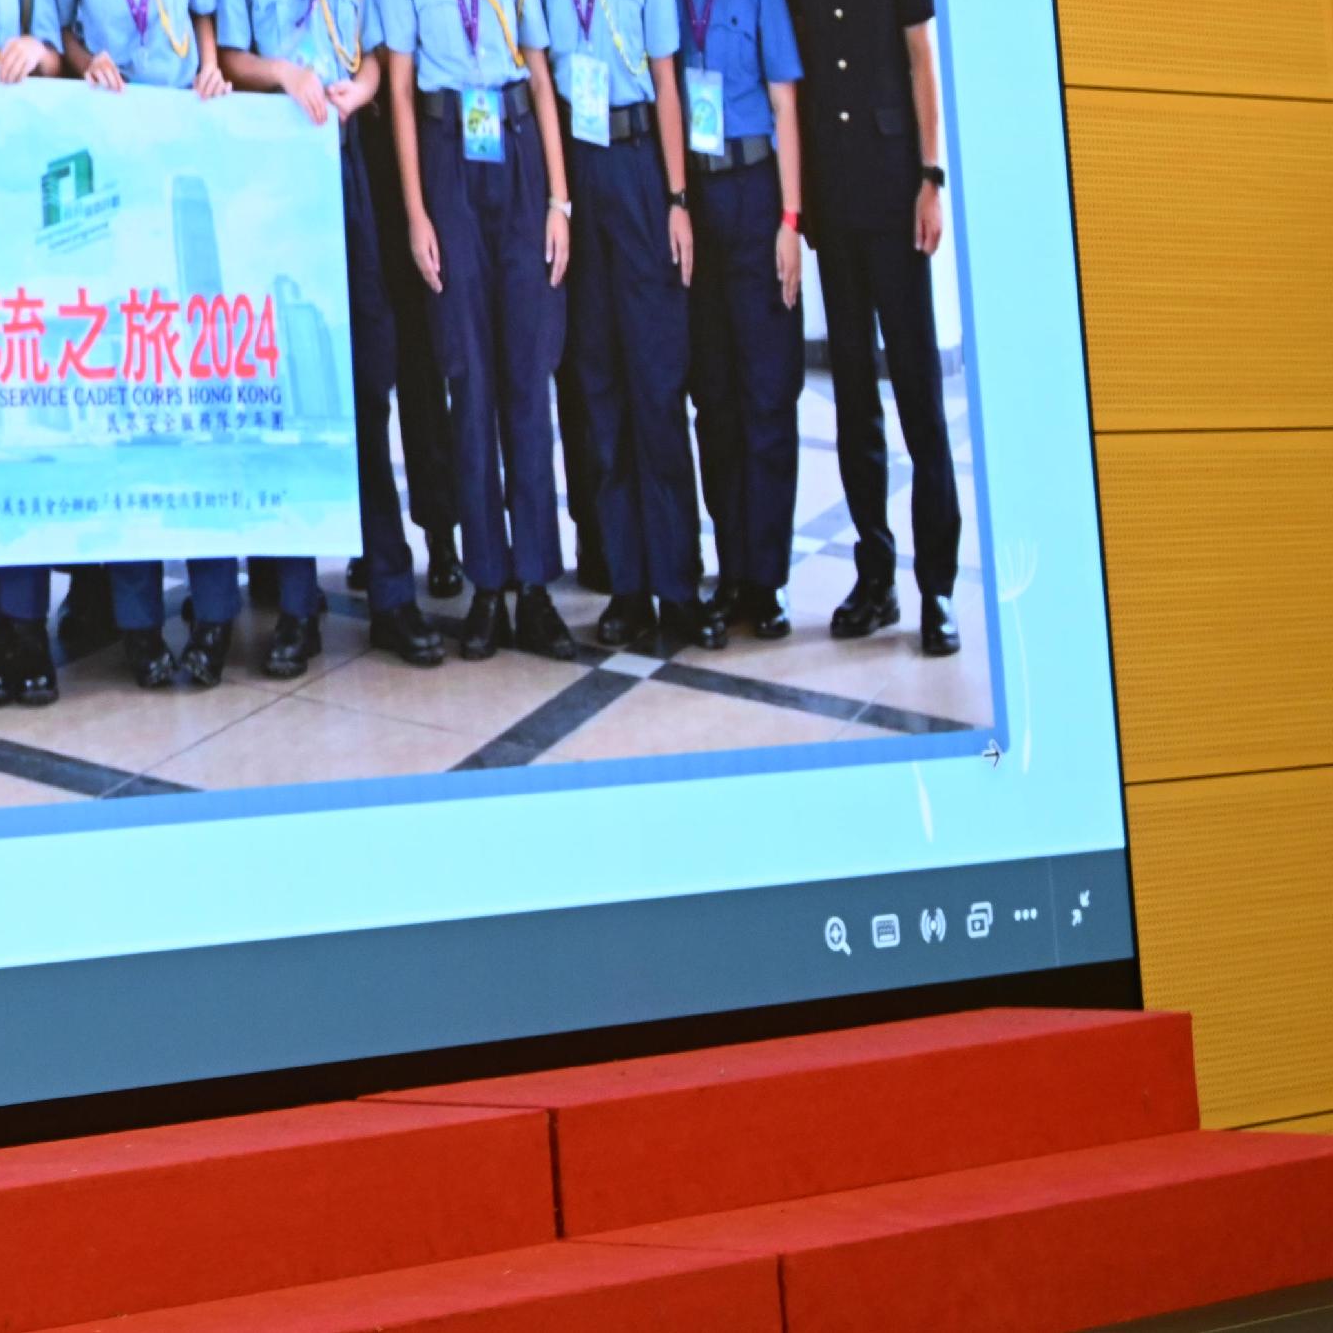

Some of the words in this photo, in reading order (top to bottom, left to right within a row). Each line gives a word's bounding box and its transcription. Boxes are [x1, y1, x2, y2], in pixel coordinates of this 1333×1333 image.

[73, 387, 127, 407] CADET
[132, 387, 183, 406] CORPS
[188, 386, 232, 405] HONG
[237, 385, 283, 405] KONG
